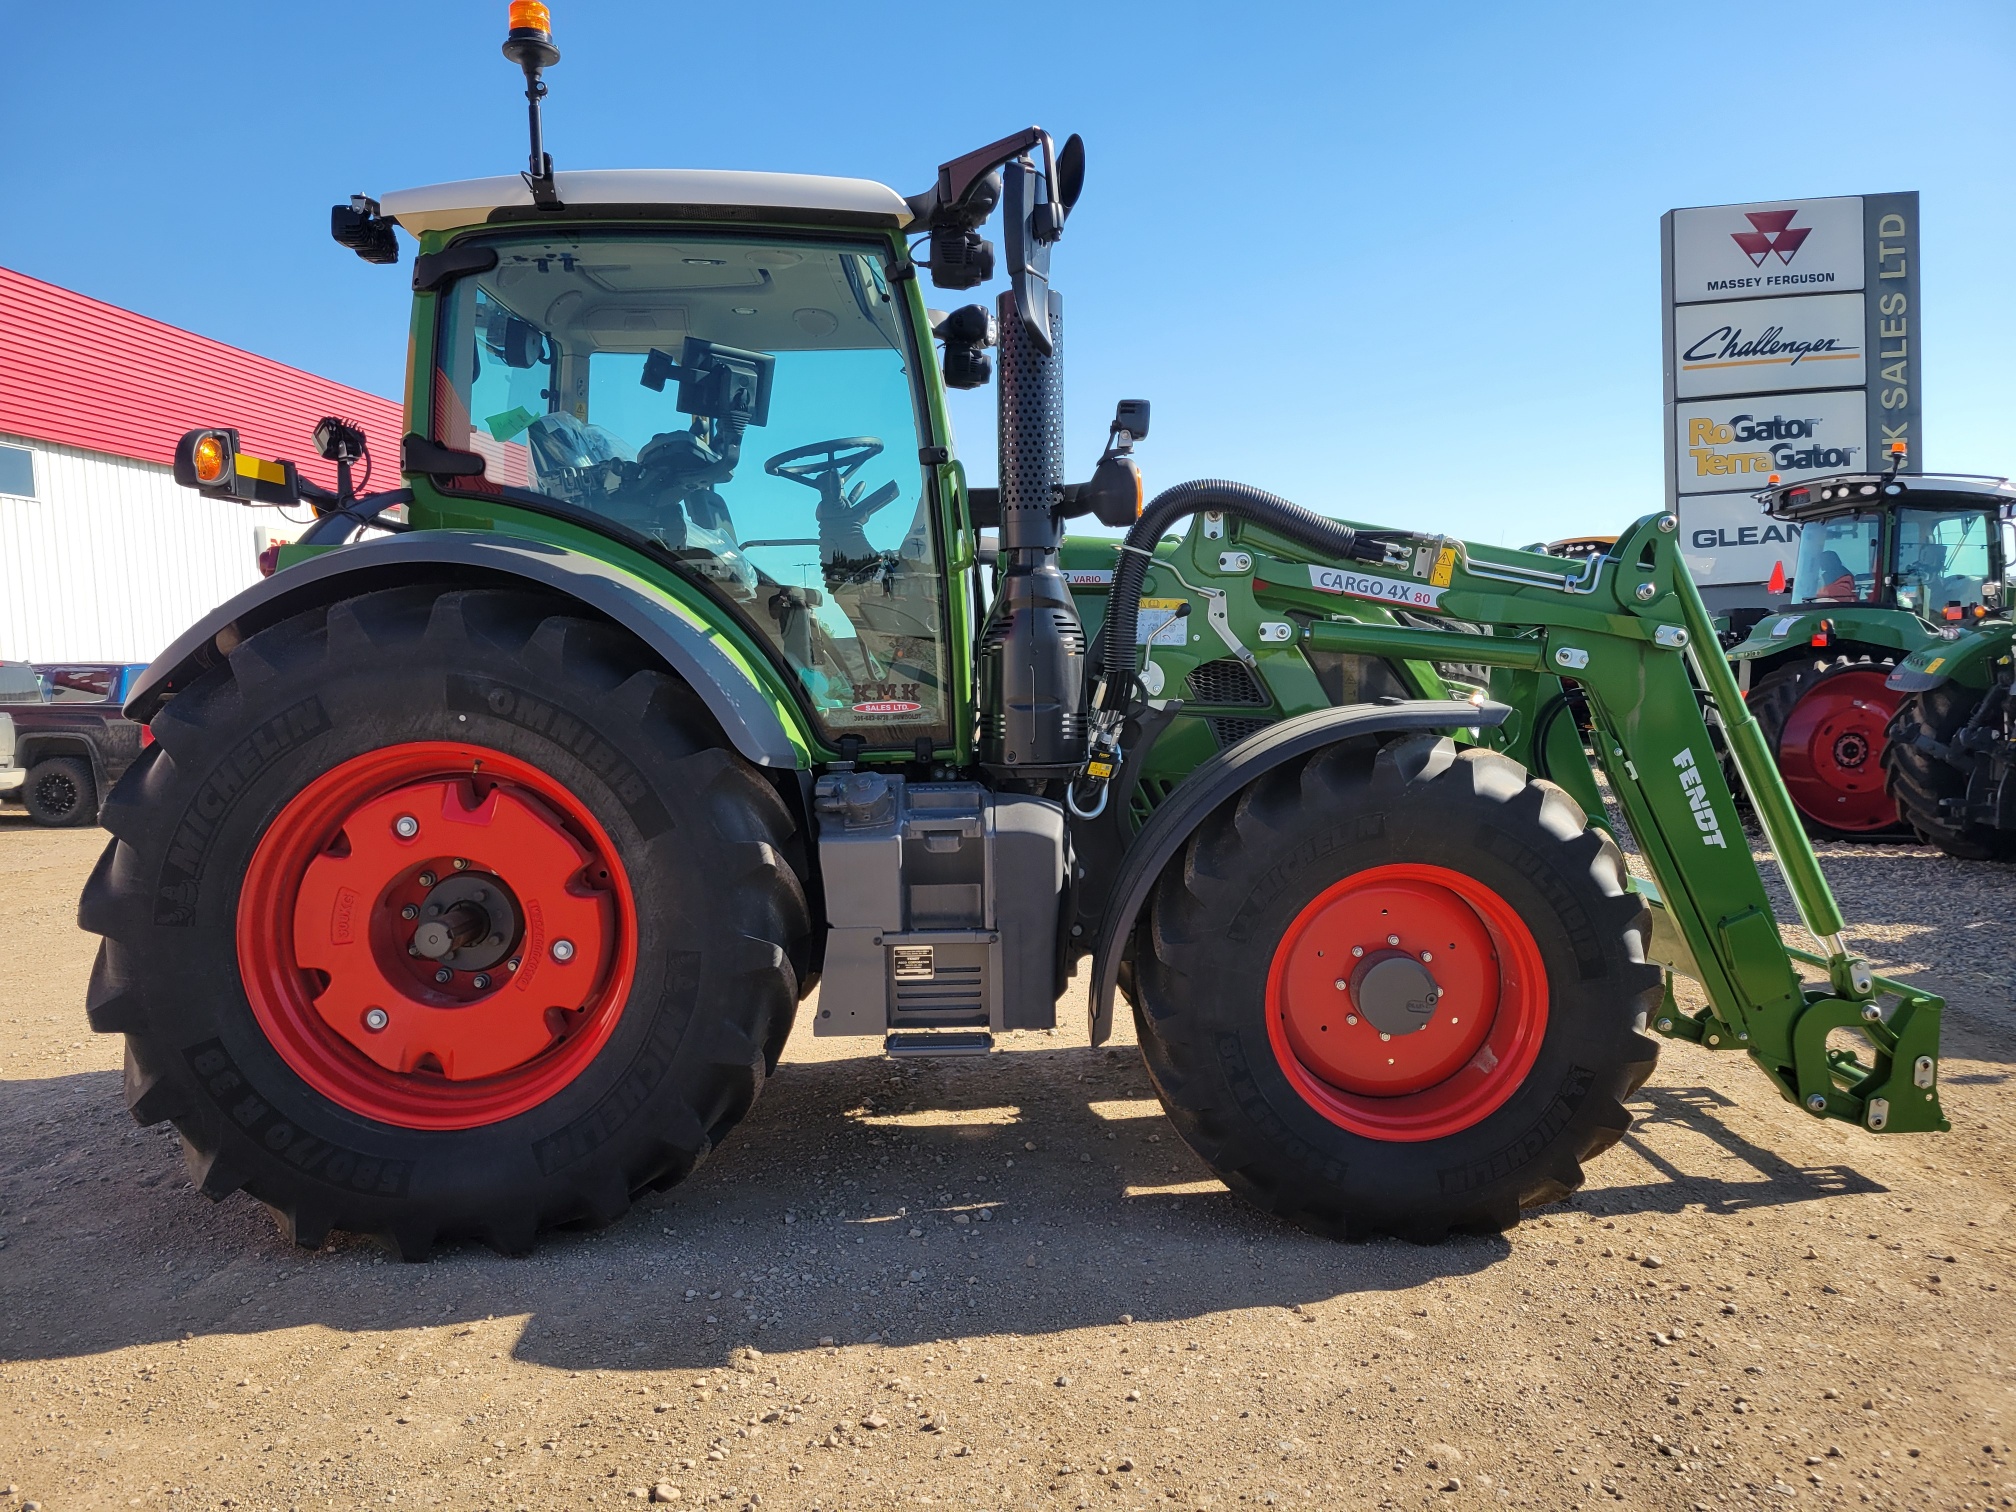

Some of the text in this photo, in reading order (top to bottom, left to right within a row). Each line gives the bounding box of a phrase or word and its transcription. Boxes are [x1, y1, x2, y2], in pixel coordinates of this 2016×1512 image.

[1707, 272, 1835, 291] MASSEY FERGUSON
[1879, 213, 1906, 279] LTD
[1682, 326, 1860, 366] Challenger
[1879, 293, 1908, 409] SALES
[1688, 414, 1820, 447] RoGator
[1689, 442, 1858, 477] TerraGator
[1073, 575, 1102, 583] VARIO
[1320, 572, 1431, 604] CARGO 4X 80
[488, 687, 647, 805] OMNIBIB
[865, 703, 910, 712] SALES LTD.
[168, 699, 320, 875] MICHELIN
[1672, 747, 1728, 849] FENDT
[1250, 817, 1381, 912] MICHELIN
[1490, 834, 1600, 961] MULTIBIB
[194, 1049, 405, 1193] 580/70 R 38
[541, 1003, 690, 1175] MICHELIN
[1444, 1098, 1573, 1193] MICHELIN
